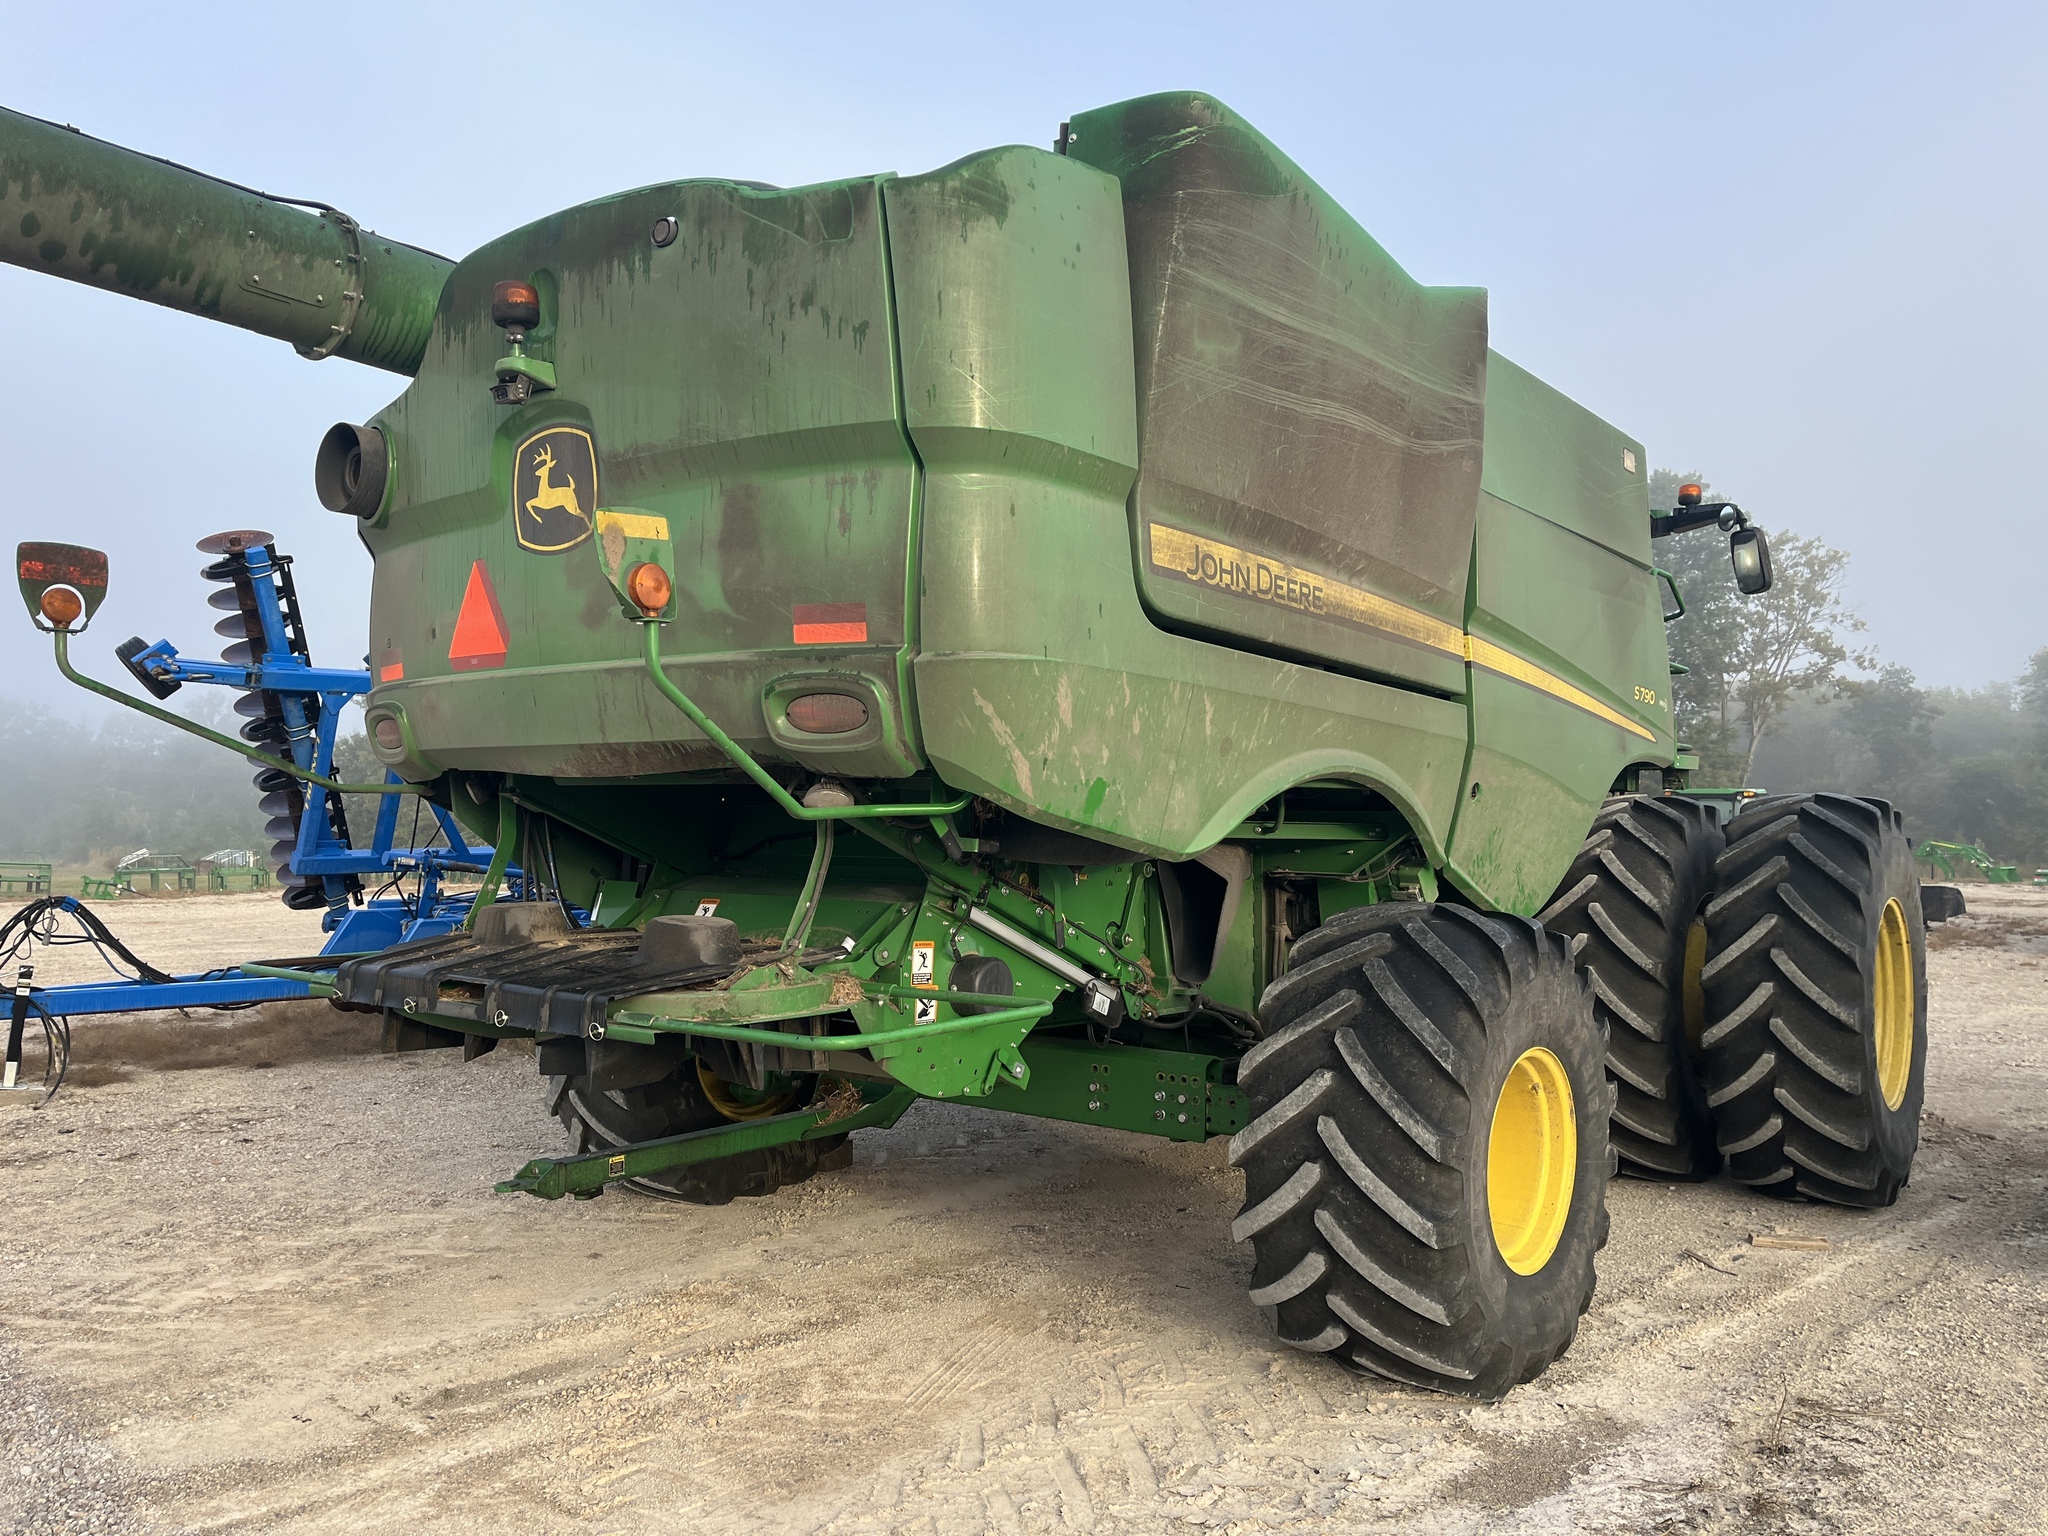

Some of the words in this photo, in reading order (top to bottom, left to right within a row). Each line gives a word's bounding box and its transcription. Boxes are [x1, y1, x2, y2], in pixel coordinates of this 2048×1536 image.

[1186, 543, 1251, 591] JOHN
[1256, 562, 1324, 610] DEERE
[1633, 685, 1656, 706] S790
